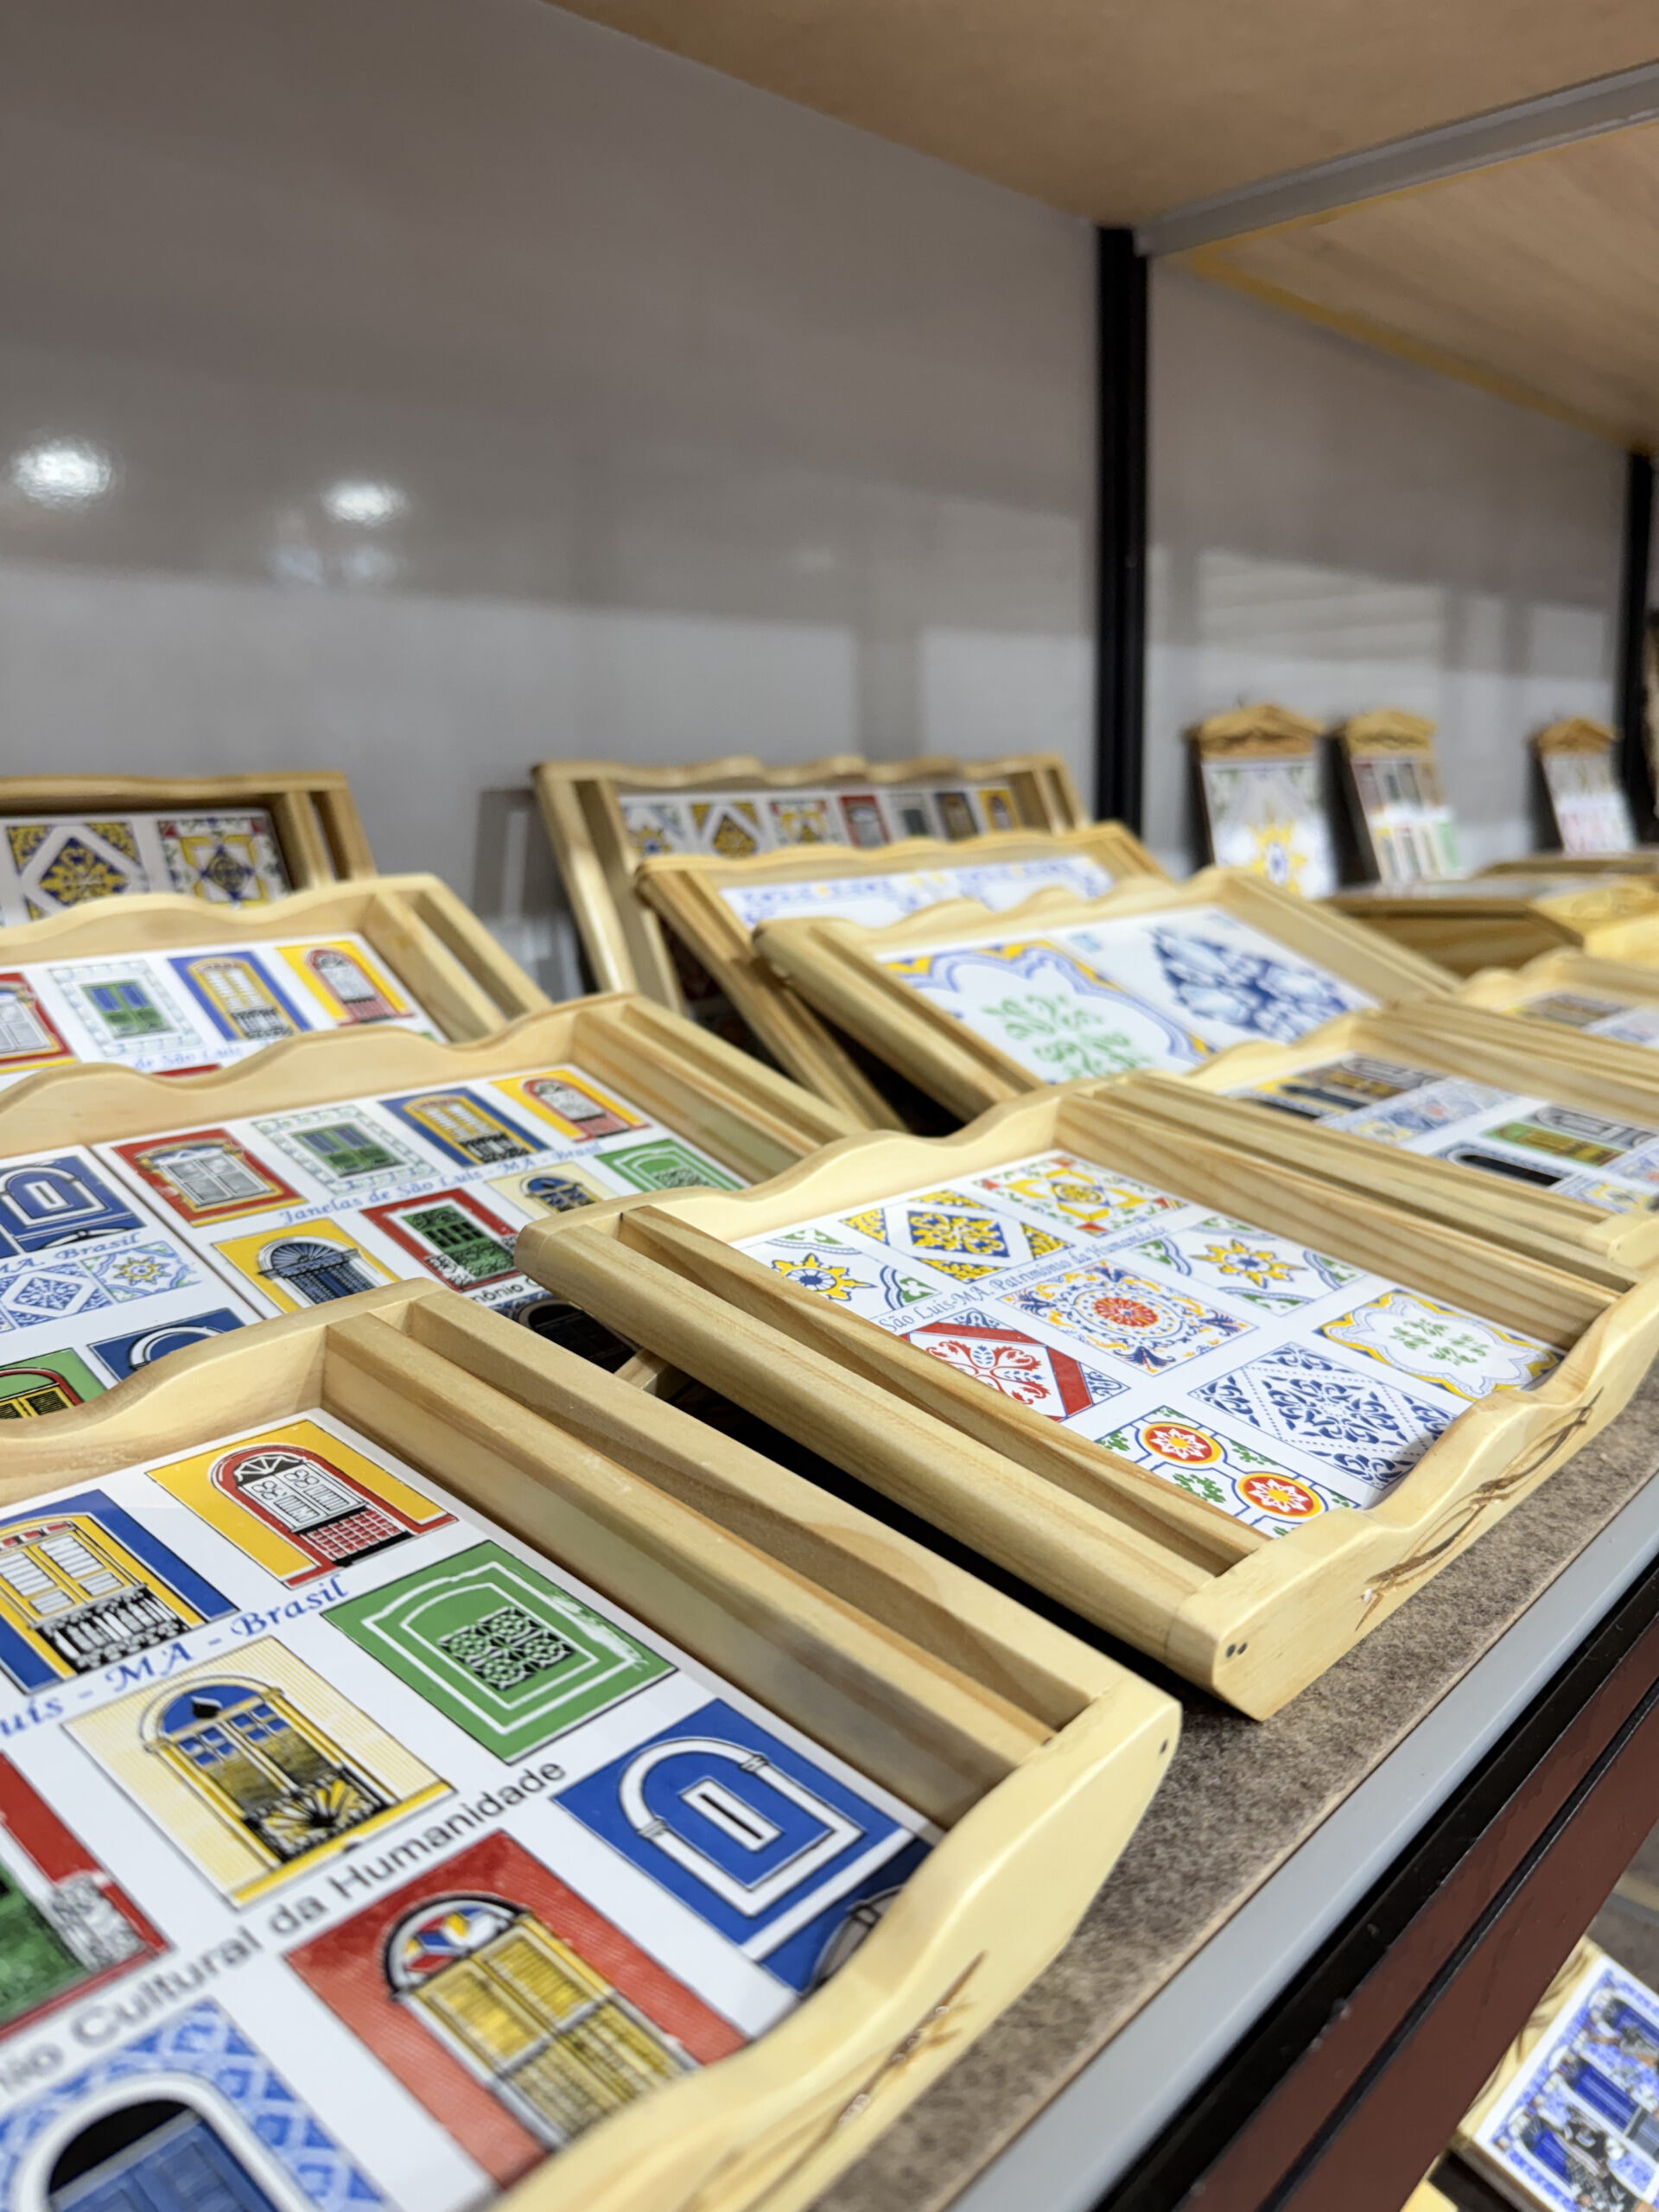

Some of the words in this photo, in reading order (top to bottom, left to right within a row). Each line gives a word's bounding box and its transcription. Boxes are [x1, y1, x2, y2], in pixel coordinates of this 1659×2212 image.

[280, 1197, 363, 1225] Janelas
[369, 1187, 391, 1203] de
[55, 1231, 141, 1260] Brasil
[879, 1314, 914, 1332] São
[0, 1697, 64, 1737] uís
[105, 1643, 193, 1693] MA
[231, 1574, 348, 1637] Brasil
[70, 1925, 264, 2048] Cultural
[270, 1896, 329, 1936] da
[327, 1761, 566, 1898] Humanidade
